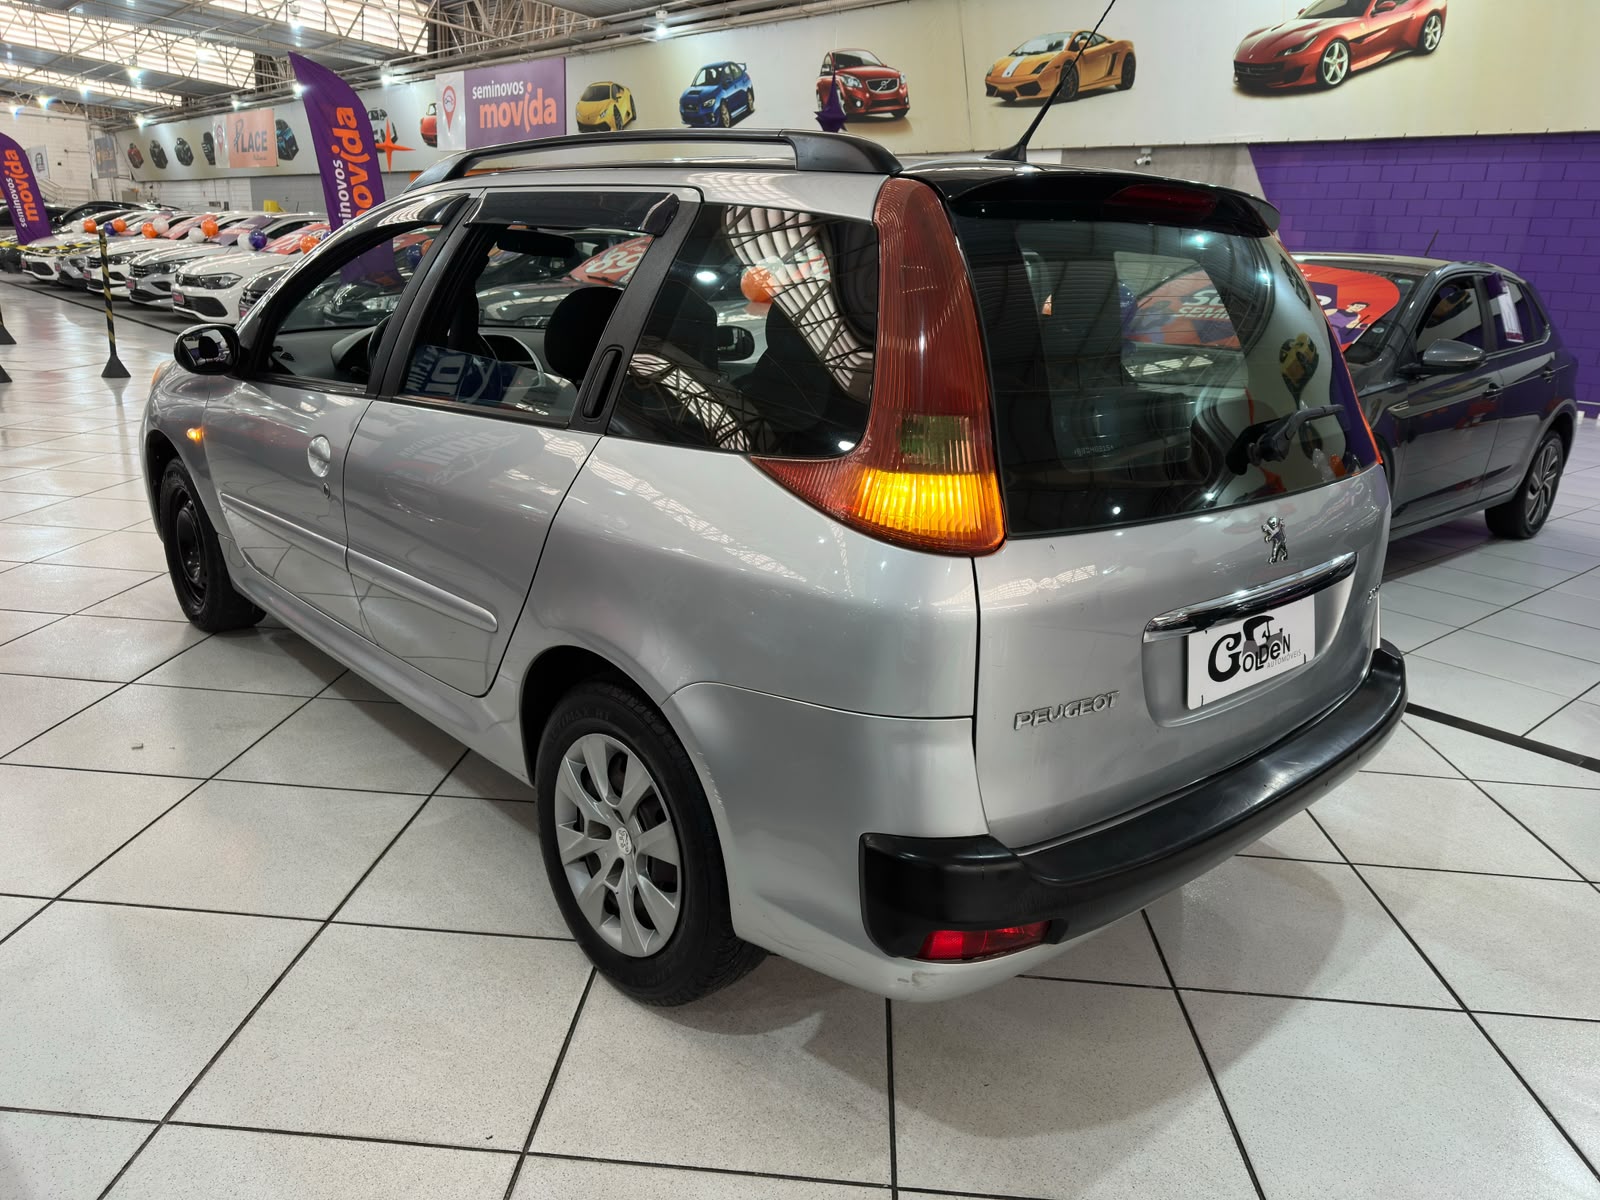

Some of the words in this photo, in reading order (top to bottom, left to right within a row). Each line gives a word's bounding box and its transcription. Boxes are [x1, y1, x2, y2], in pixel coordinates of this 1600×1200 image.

[472, 80, 524, 99] seminovos
[479, 82, 557, 133] movida
[4, 149, 39, 222] movida
[331, 107, 374, 217] ovida
[6, 177, 28, 228] seminovos
[333, 159, 352, 225] inovos
[1267, 649, 1302, 668] AUTOMÓVEIS
[1014, 690, 1120, 730] PEUGEOT
